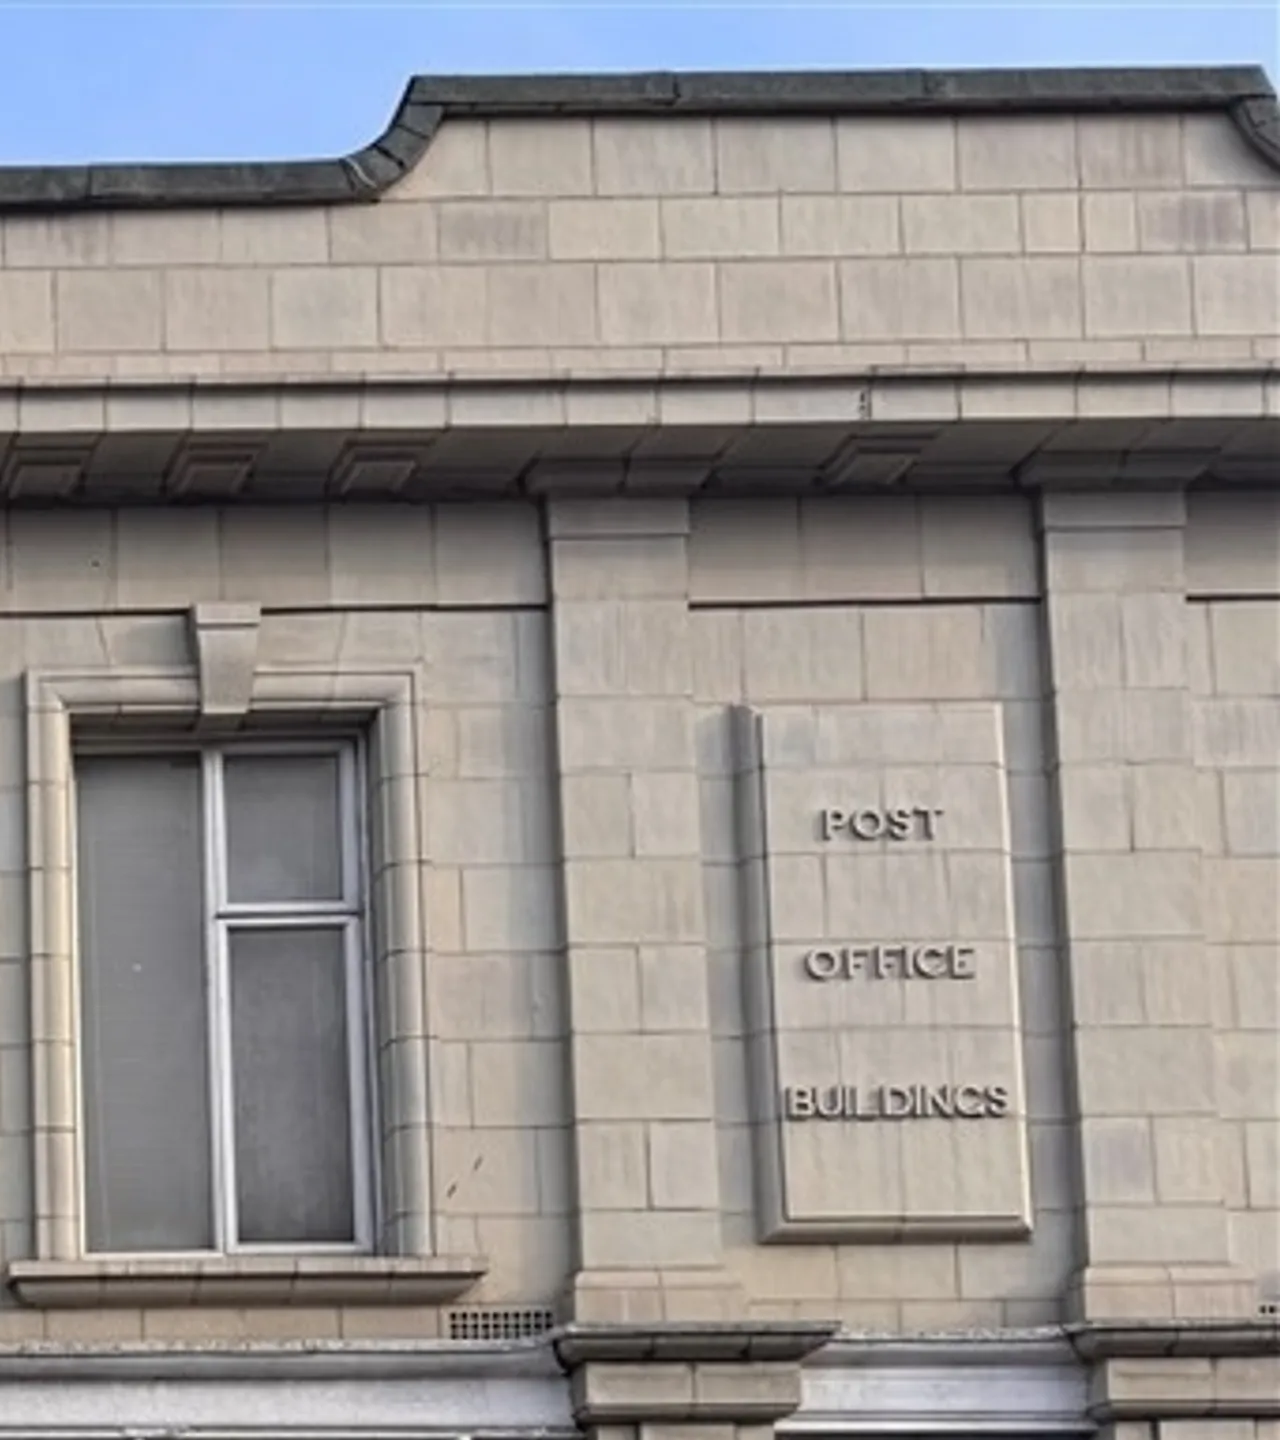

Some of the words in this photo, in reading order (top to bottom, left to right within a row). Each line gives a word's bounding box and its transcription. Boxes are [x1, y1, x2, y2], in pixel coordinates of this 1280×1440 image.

[820, 808, 944, 842] POST
[803, 946, 976, 982] OFFICE
[785, 1084, 1009, 1121] BUILDINGS
